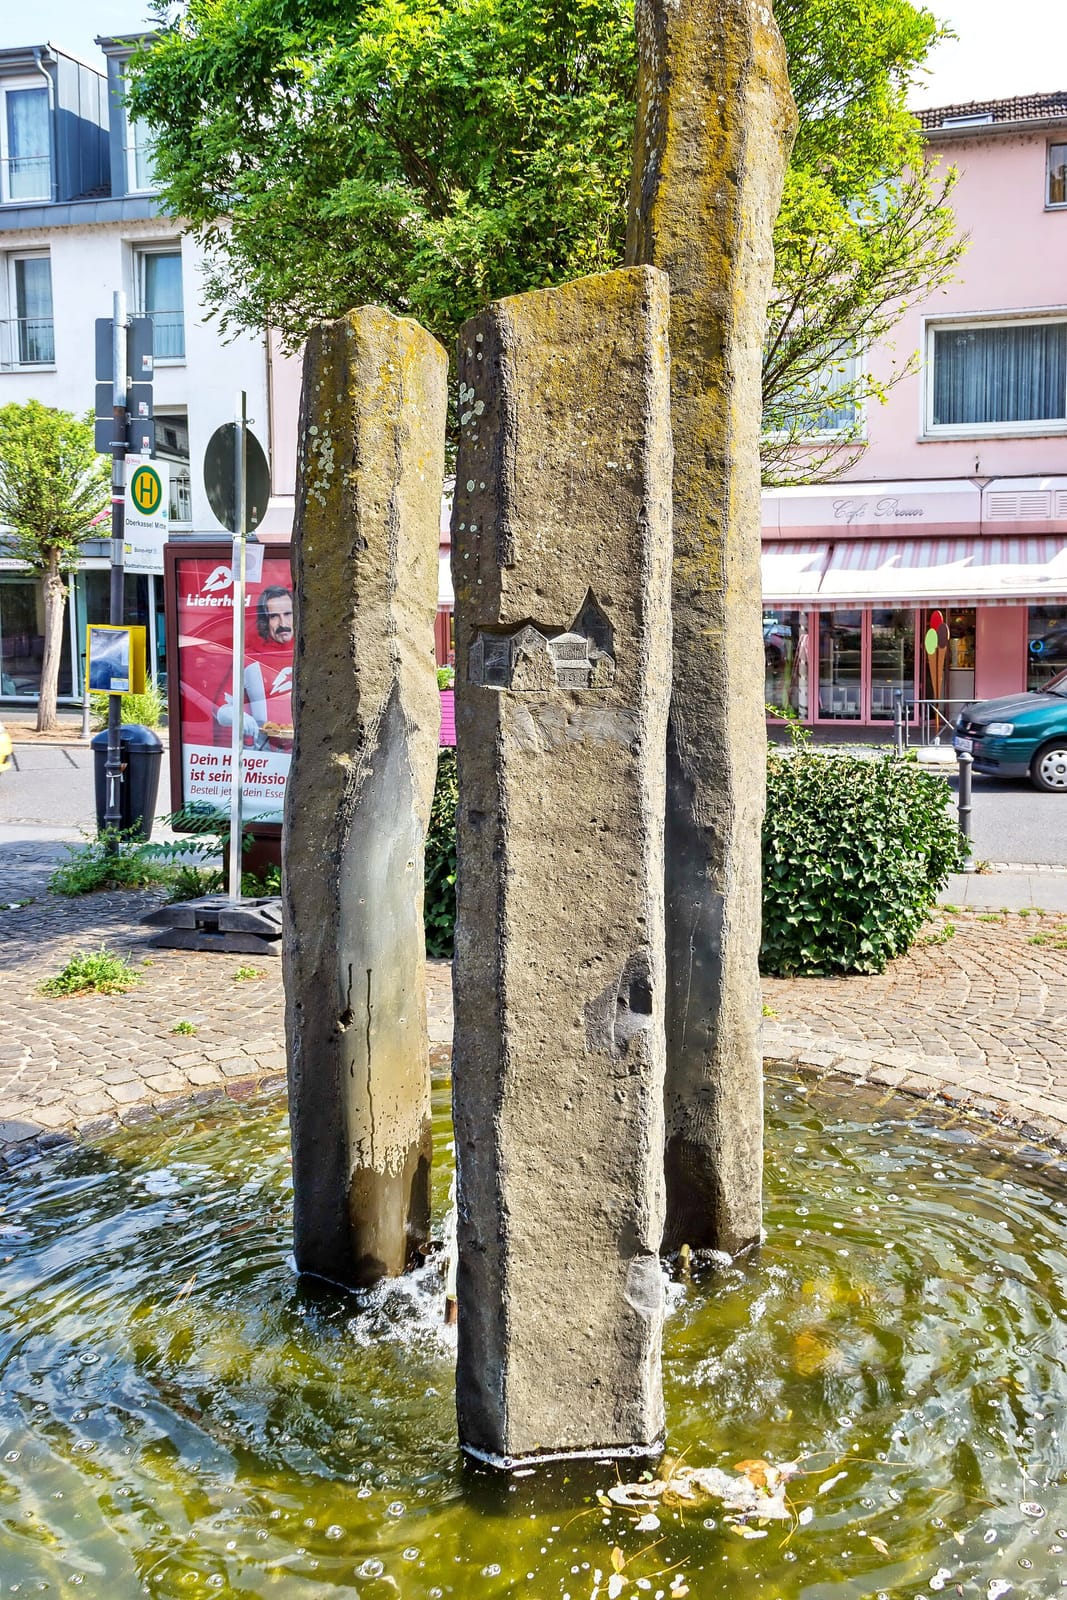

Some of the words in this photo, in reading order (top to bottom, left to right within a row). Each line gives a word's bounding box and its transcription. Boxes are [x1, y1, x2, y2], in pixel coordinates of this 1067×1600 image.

[140, 475, 153, 505] H
[125, 518, 153, 528] Oberkassel
[154, 521, 167, 530] Mitte
[186, 593, 252, 607] Lieferhd
[190, 753, 218, 766] Dein
[222, 755, 269, 770] Hnger
[190, 768, 205, 781] ist
[208, 770, 232, 783] sein
[244, 772, 288, 785] Missio
[190, 785, 218, 795] Bestell
[220, 786, 232, 797] jet
[243, 787, 262, 798] dein
[265, 788, 284, 799] Esse
